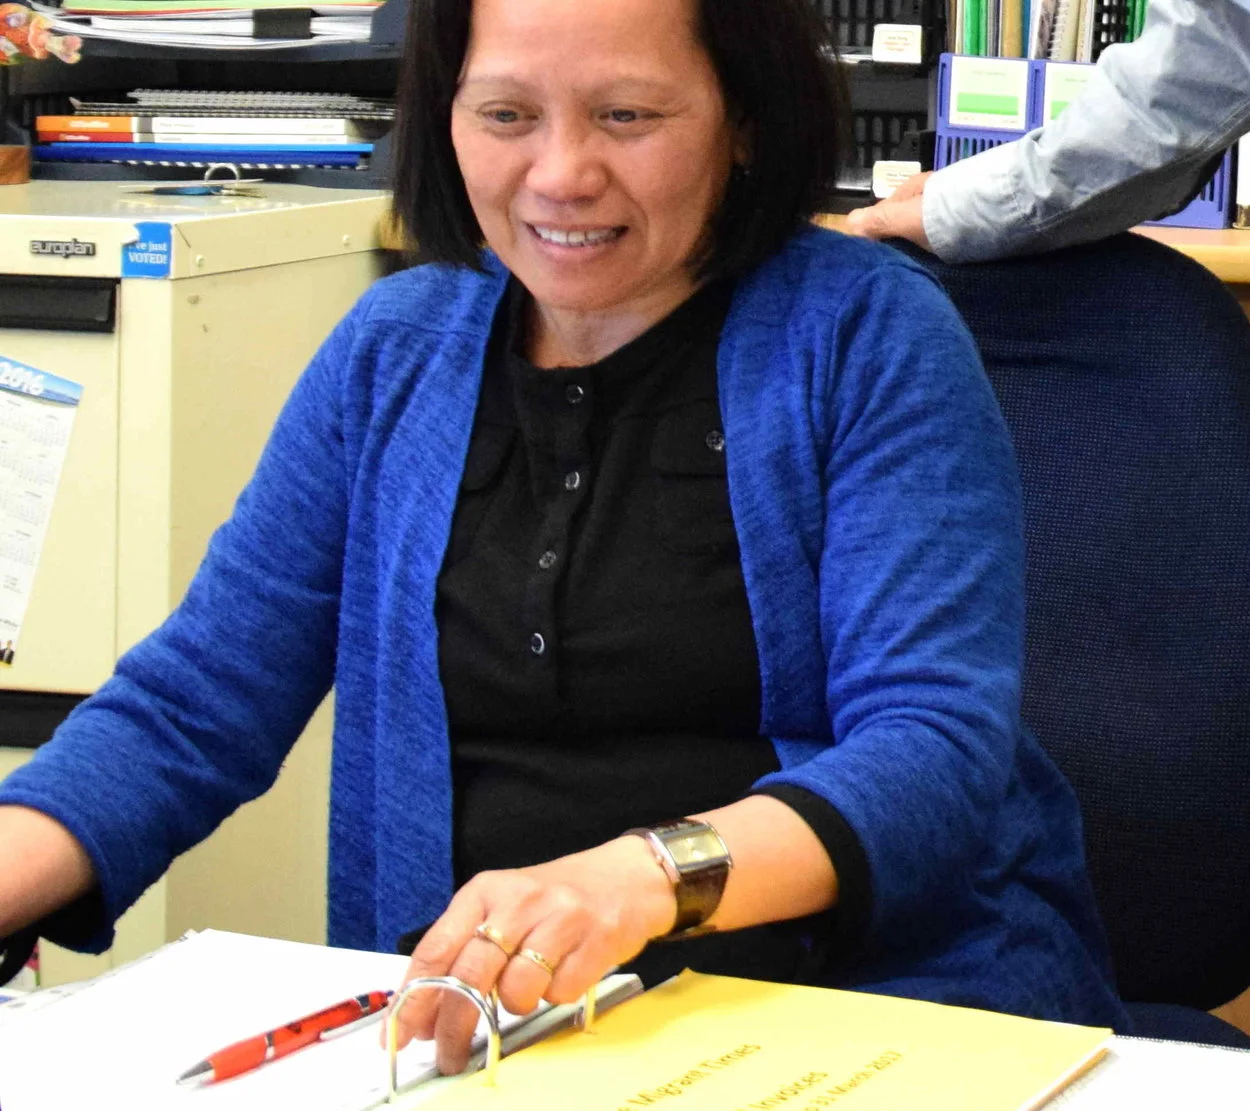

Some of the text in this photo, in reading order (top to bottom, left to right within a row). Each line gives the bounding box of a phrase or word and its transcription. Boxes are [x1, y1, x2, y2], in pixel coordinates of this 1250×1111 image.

[31, 238, 95, 259] europlan
[148, 241, 168, 252] just
[128, 252, 168, 264] VOTED!
[626, 1042, 762, 1107] Migrant Times
[748, 1069, 830, 1111] Invoices
